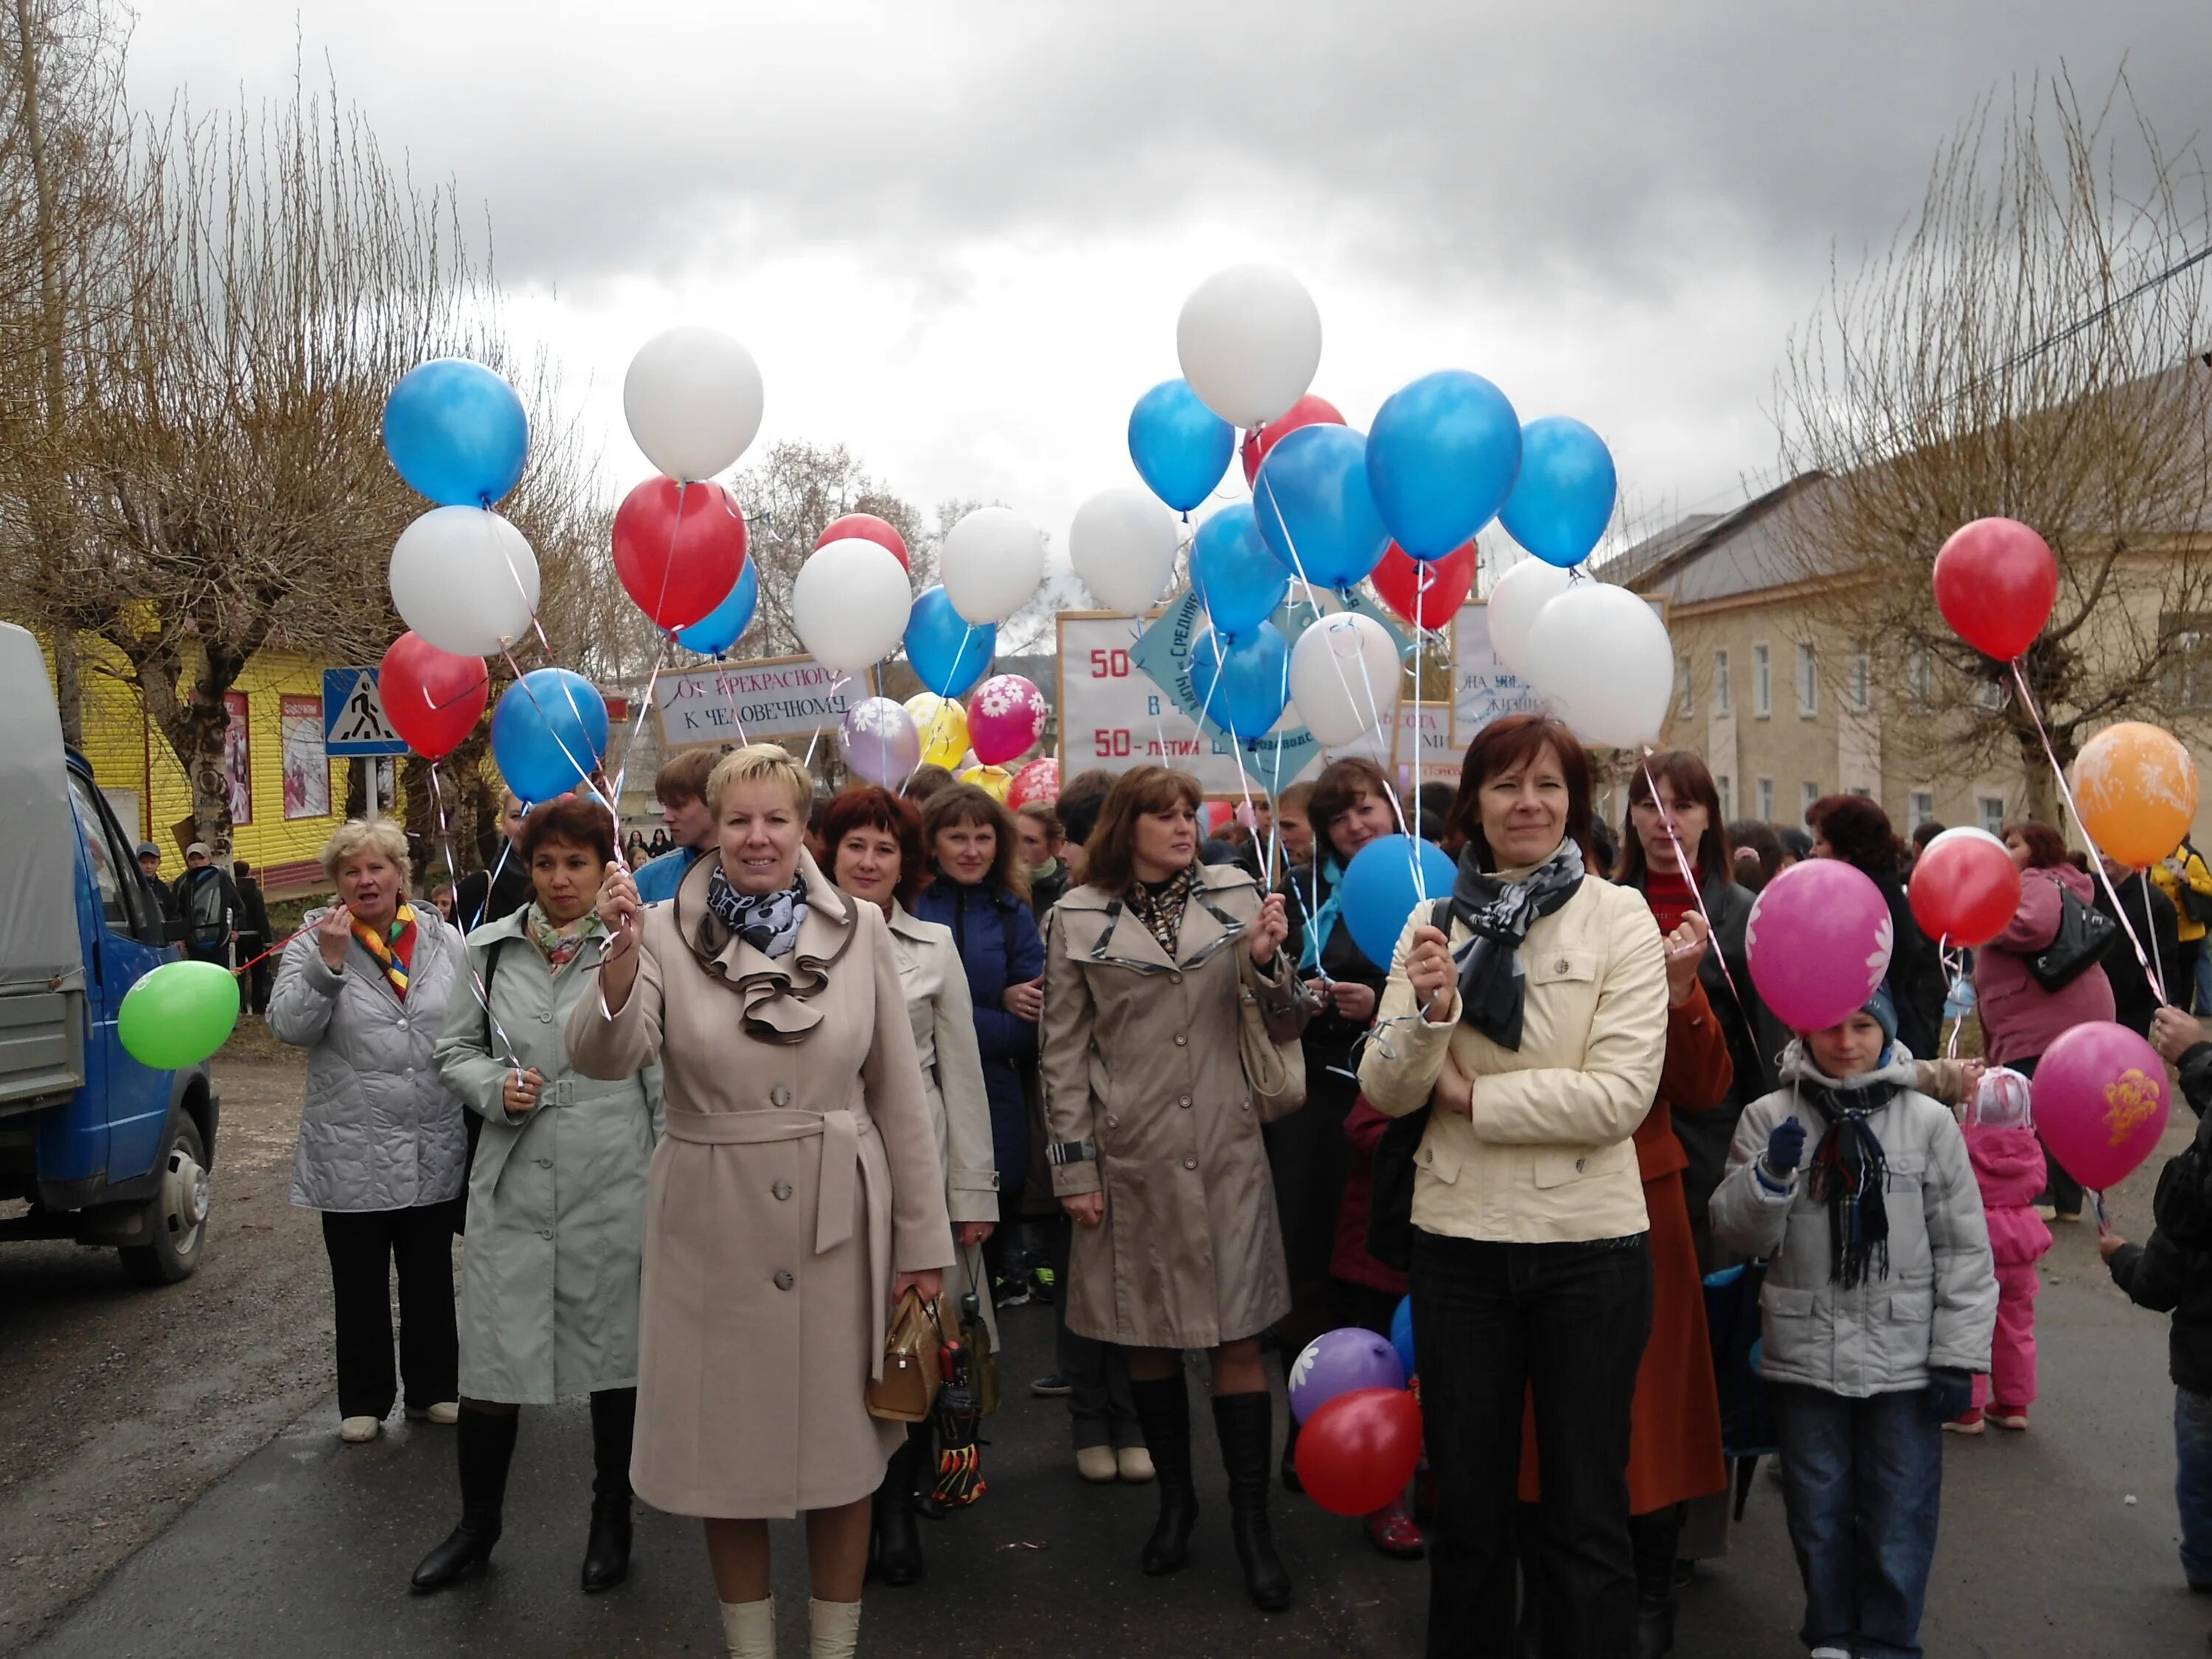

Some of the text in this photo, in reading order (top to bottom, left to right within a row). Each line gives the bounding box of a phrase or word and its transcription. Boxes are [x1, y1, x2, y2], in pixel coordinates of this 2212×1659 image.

[1091, 649, 1129, 678] 50
[684, 695, 849, 729] К ЧЕЛОВЕЧНОМУ
